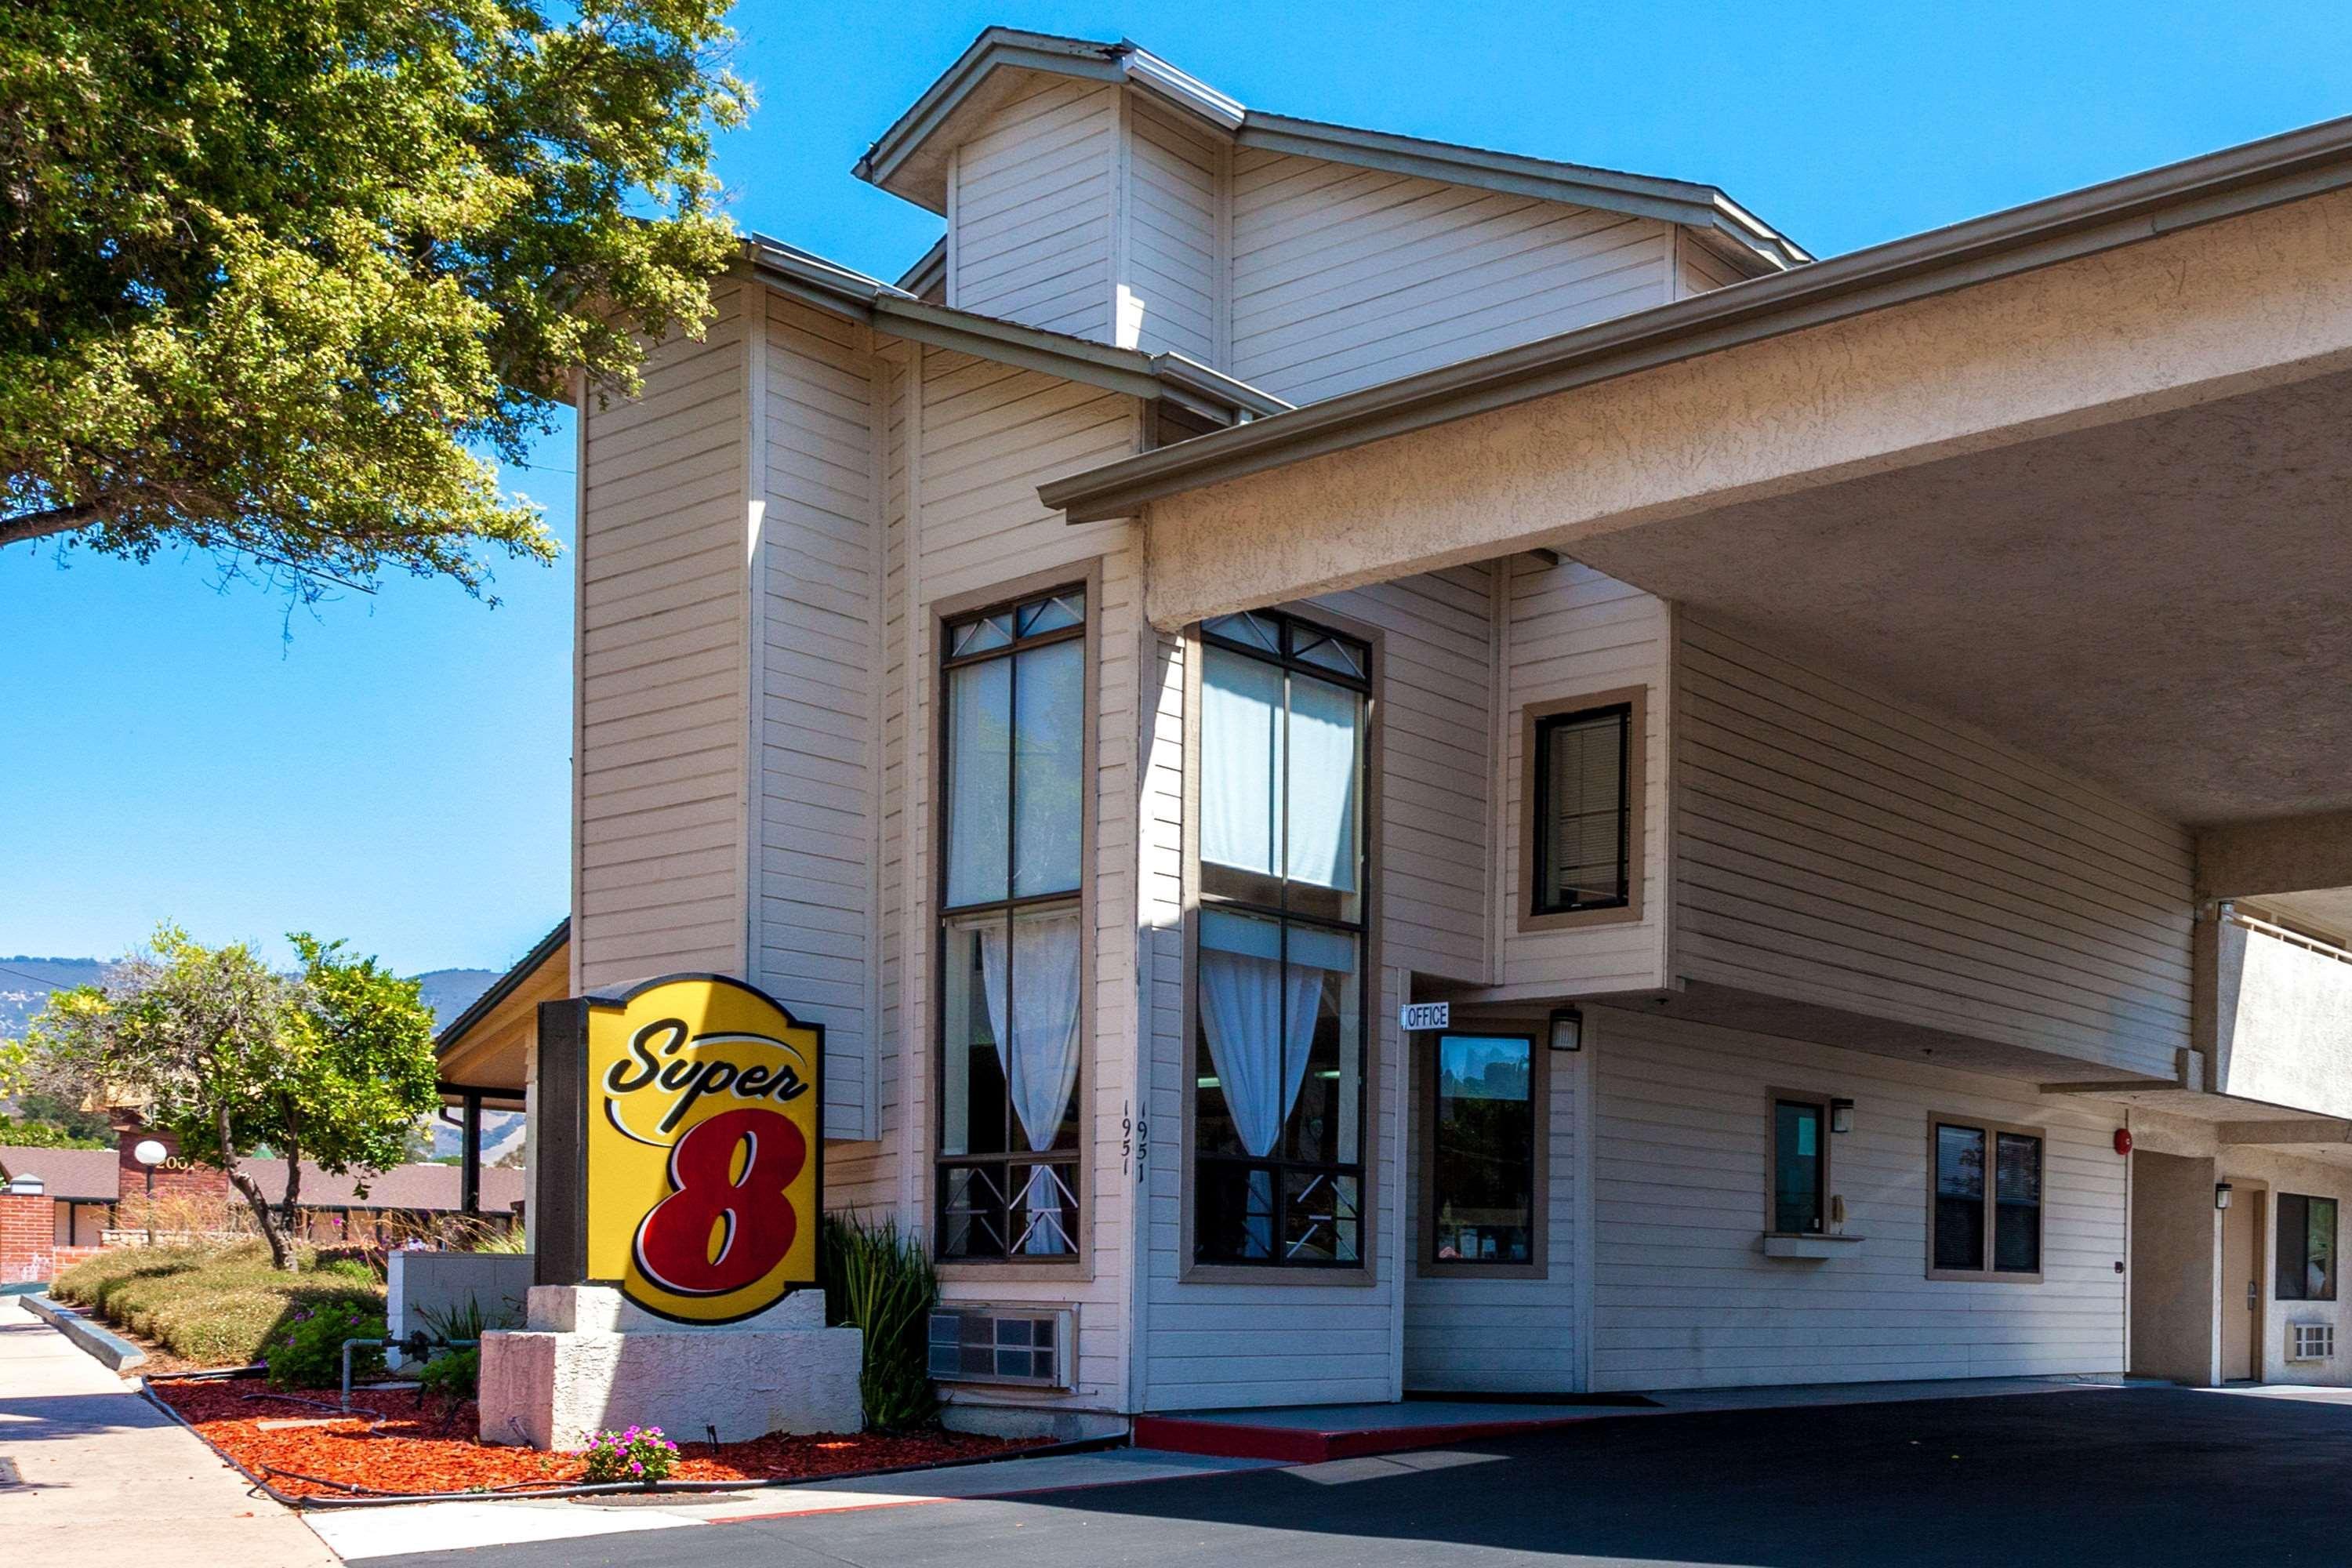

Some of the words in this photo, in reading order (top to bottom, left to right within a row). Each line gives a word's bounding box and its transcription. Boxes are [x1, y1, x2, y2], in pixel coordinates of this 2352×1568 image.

[1408, 1005, 1446, 1027] OFFICE
[604, 1018, 809, 1134] Super
[1121, 1099, 1131, 1175] 1951
[1136, 1101, 1148, 1183] 1951
[632, 1108, 806, 1298] 8
